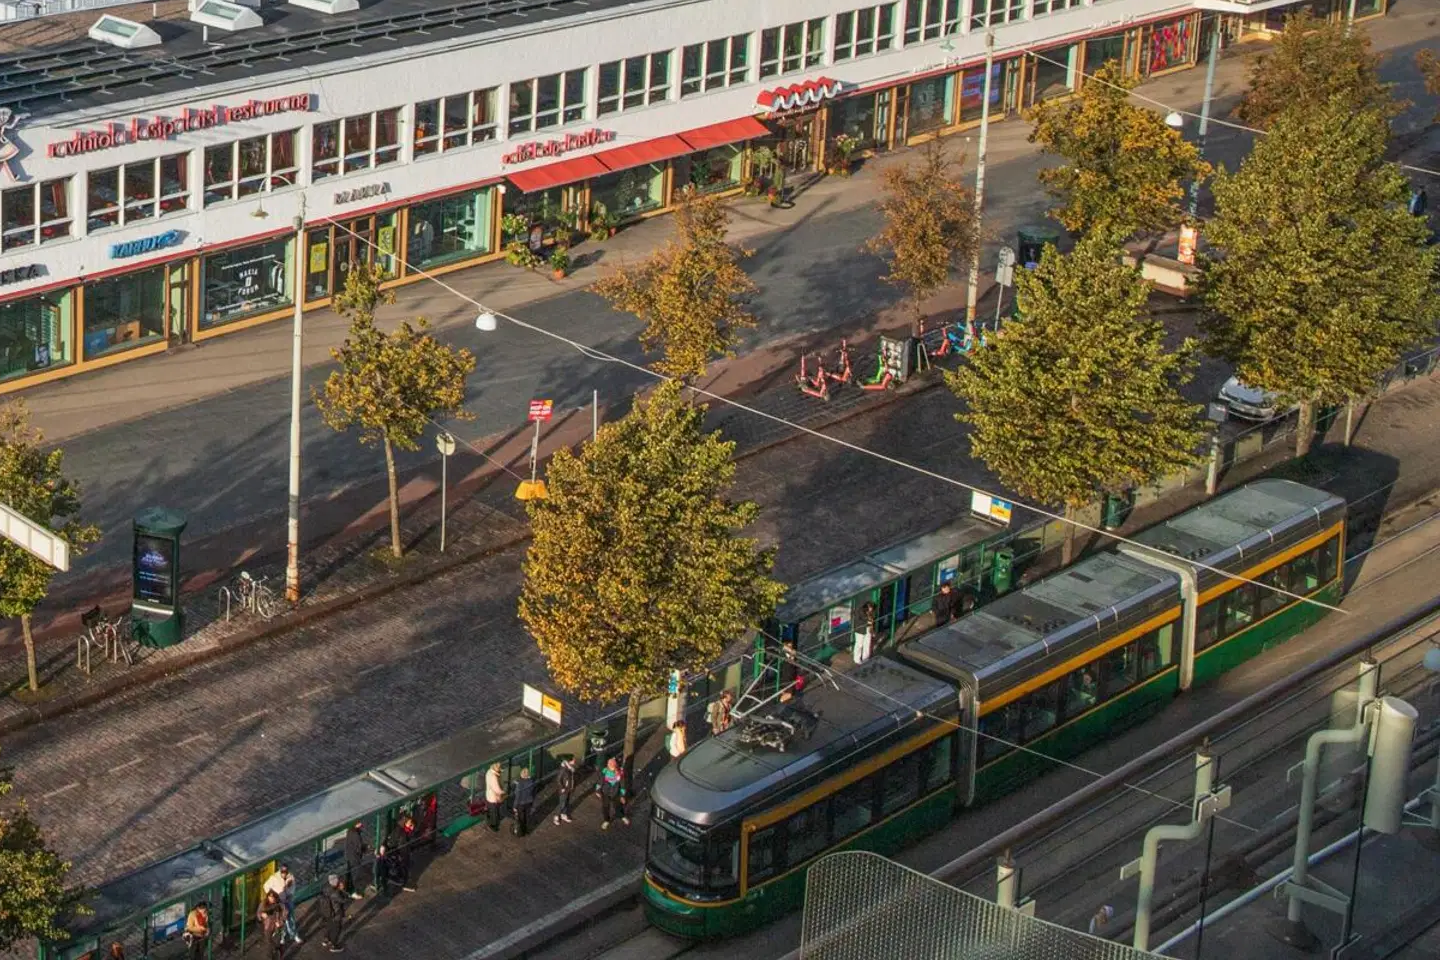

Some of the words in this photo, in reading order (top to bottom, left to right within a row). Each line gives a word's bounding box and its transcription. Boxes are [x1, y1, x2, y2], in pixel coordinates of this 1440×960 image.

[47, 121, 126, 158] ravintola
[131, 104, 218, 143] lasipalatsi
[224, 93, 311, 123] restaurang
